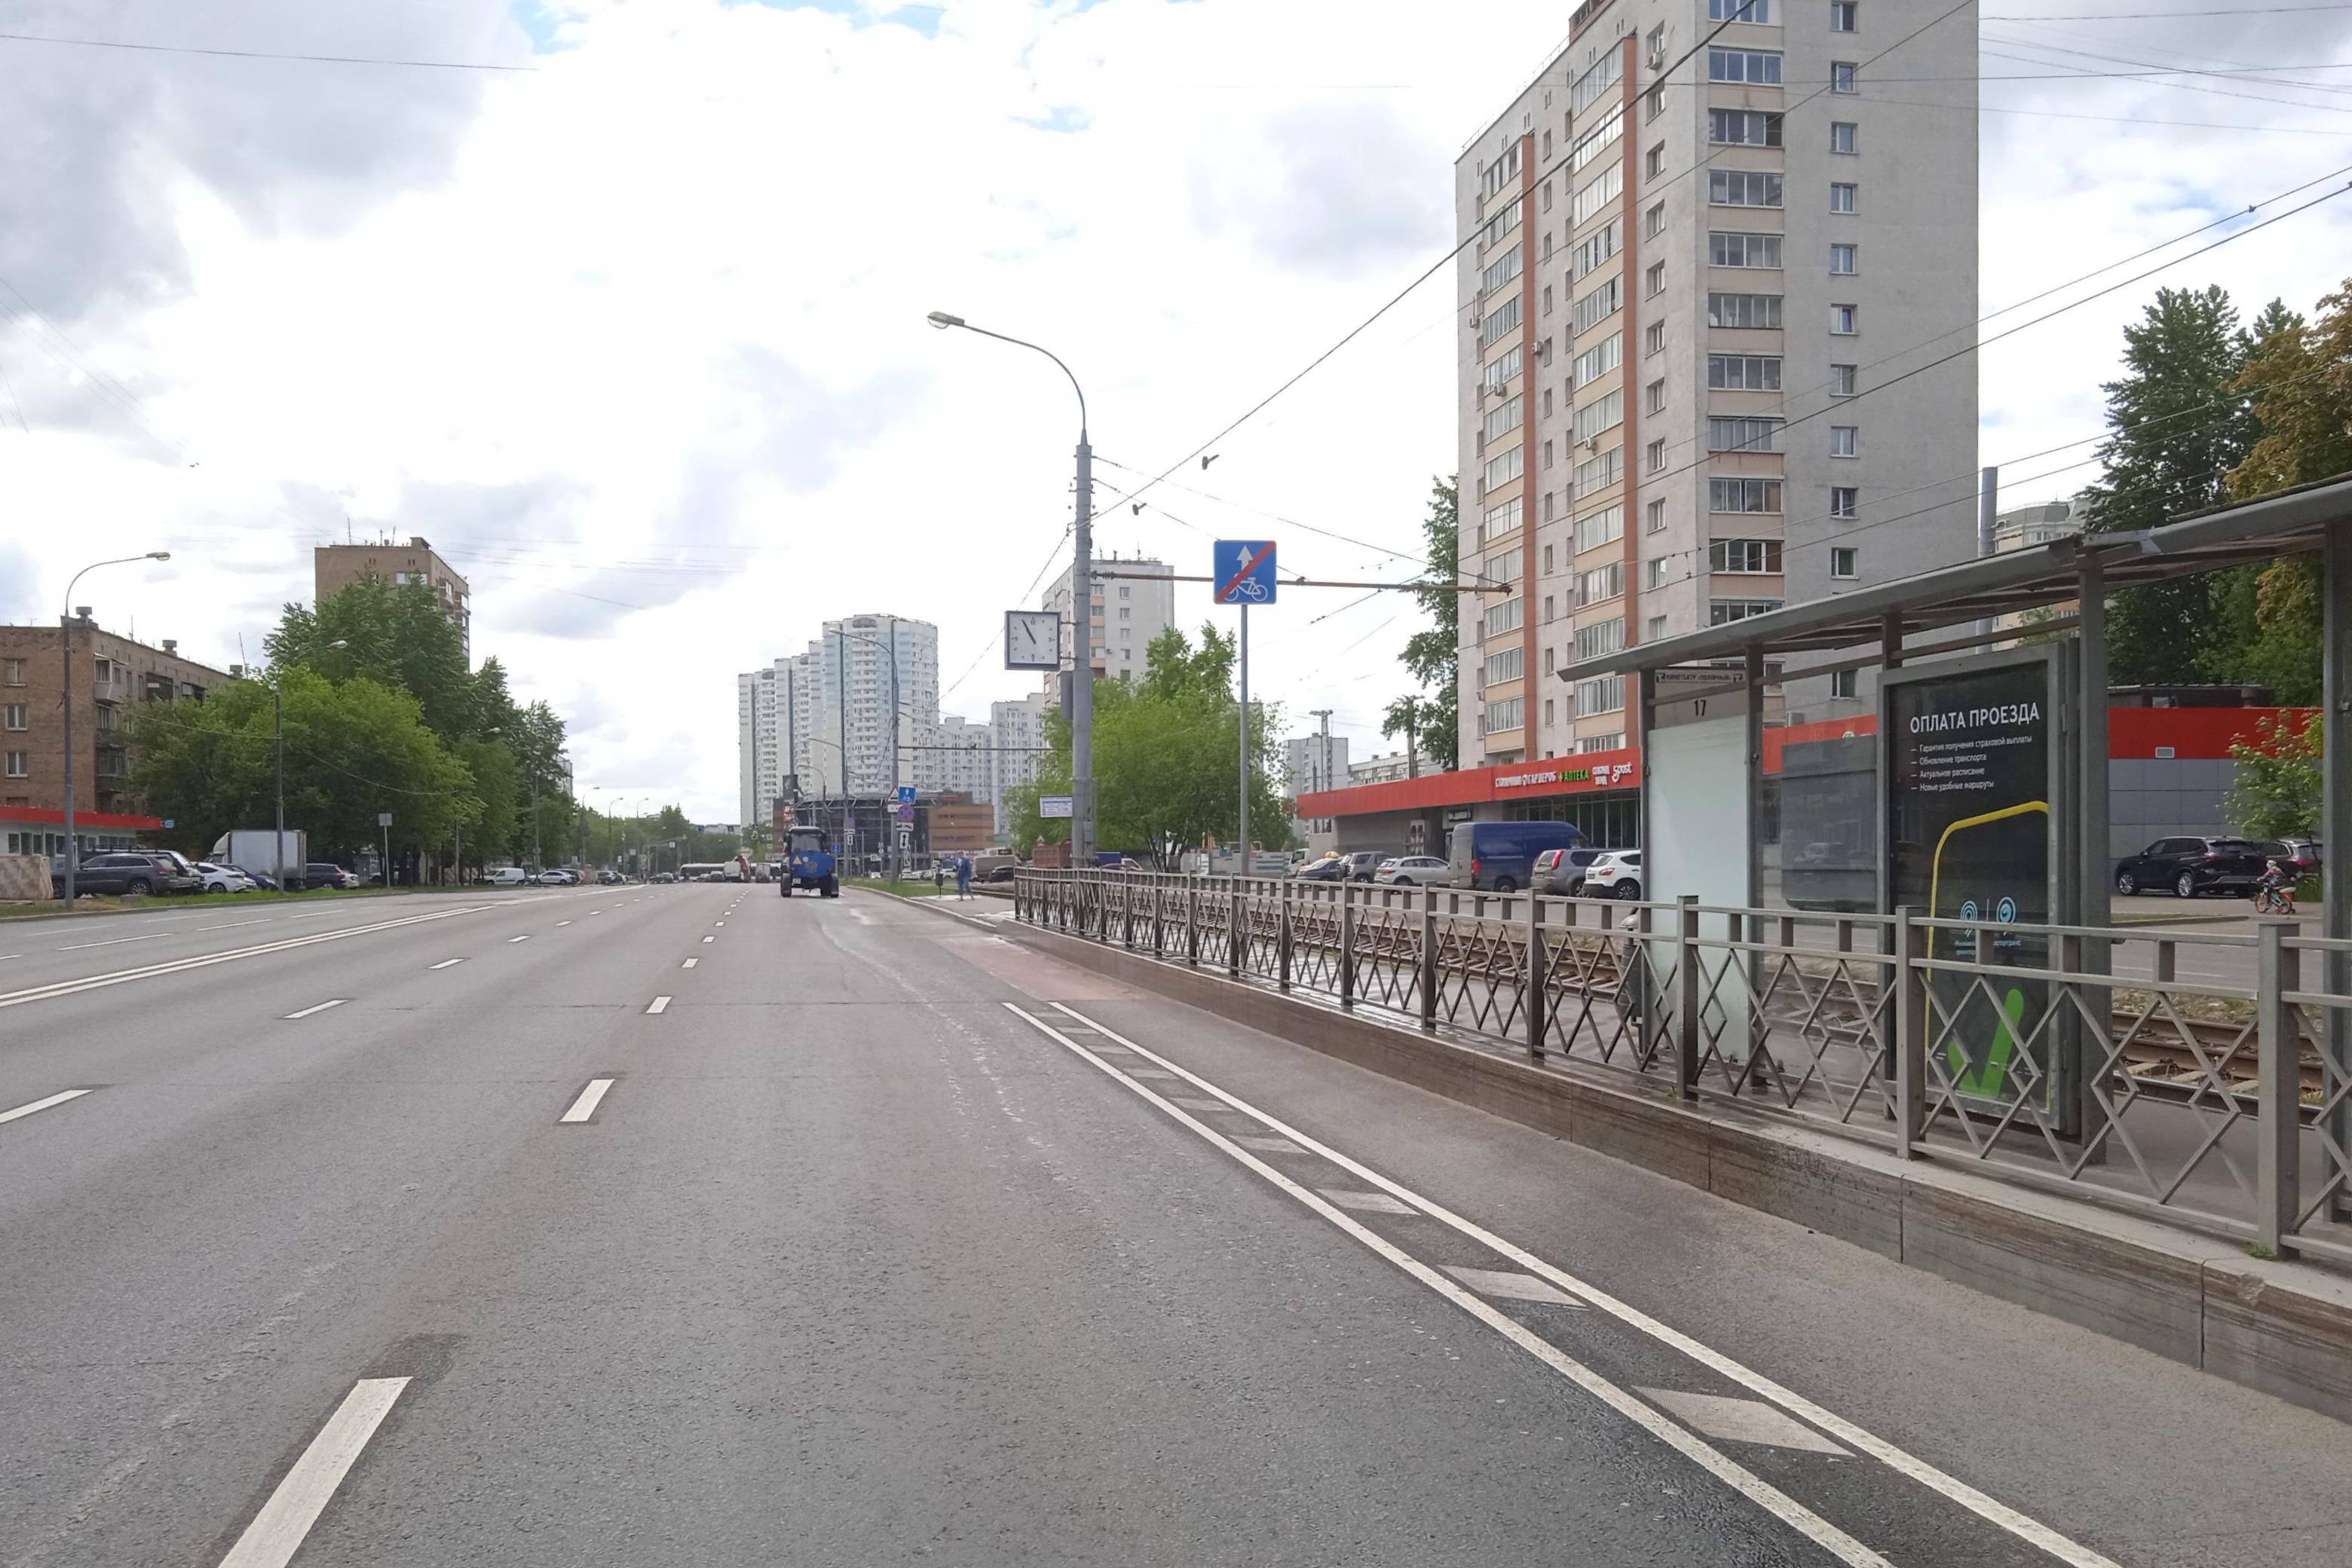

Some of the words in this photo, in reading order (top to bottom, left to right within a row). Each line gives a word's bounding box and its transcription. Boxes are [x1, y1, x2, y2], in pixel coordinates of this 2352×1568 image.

[1693, 700, 1707, 716] 17
[1909, 712, 1966, 733] ОПЛАТА
[1969, 702, 2040, 727] ПРОЕЗДА
[1919, 743, 1945, 753] Гарантия
[1946, 741, 1974, 752] получения
[1975, 737, 2005, 748] страховой
[2006, 736, 2032, 744] выплаты
[1919, 755, 1954, 765] Обновление
[1954, 753, 1987, 764] транспорта
[1563, 770, 1590, 782] АПТЕКА
[1919, 769, 1951, 779] Актуальное
[1952, 767, 1985, 777] расписание
[1919, 782, 1938, 792] Новые
[1939, 780, 1964, 792] удобные
[1964, 779, 1995, 790] маршруты
